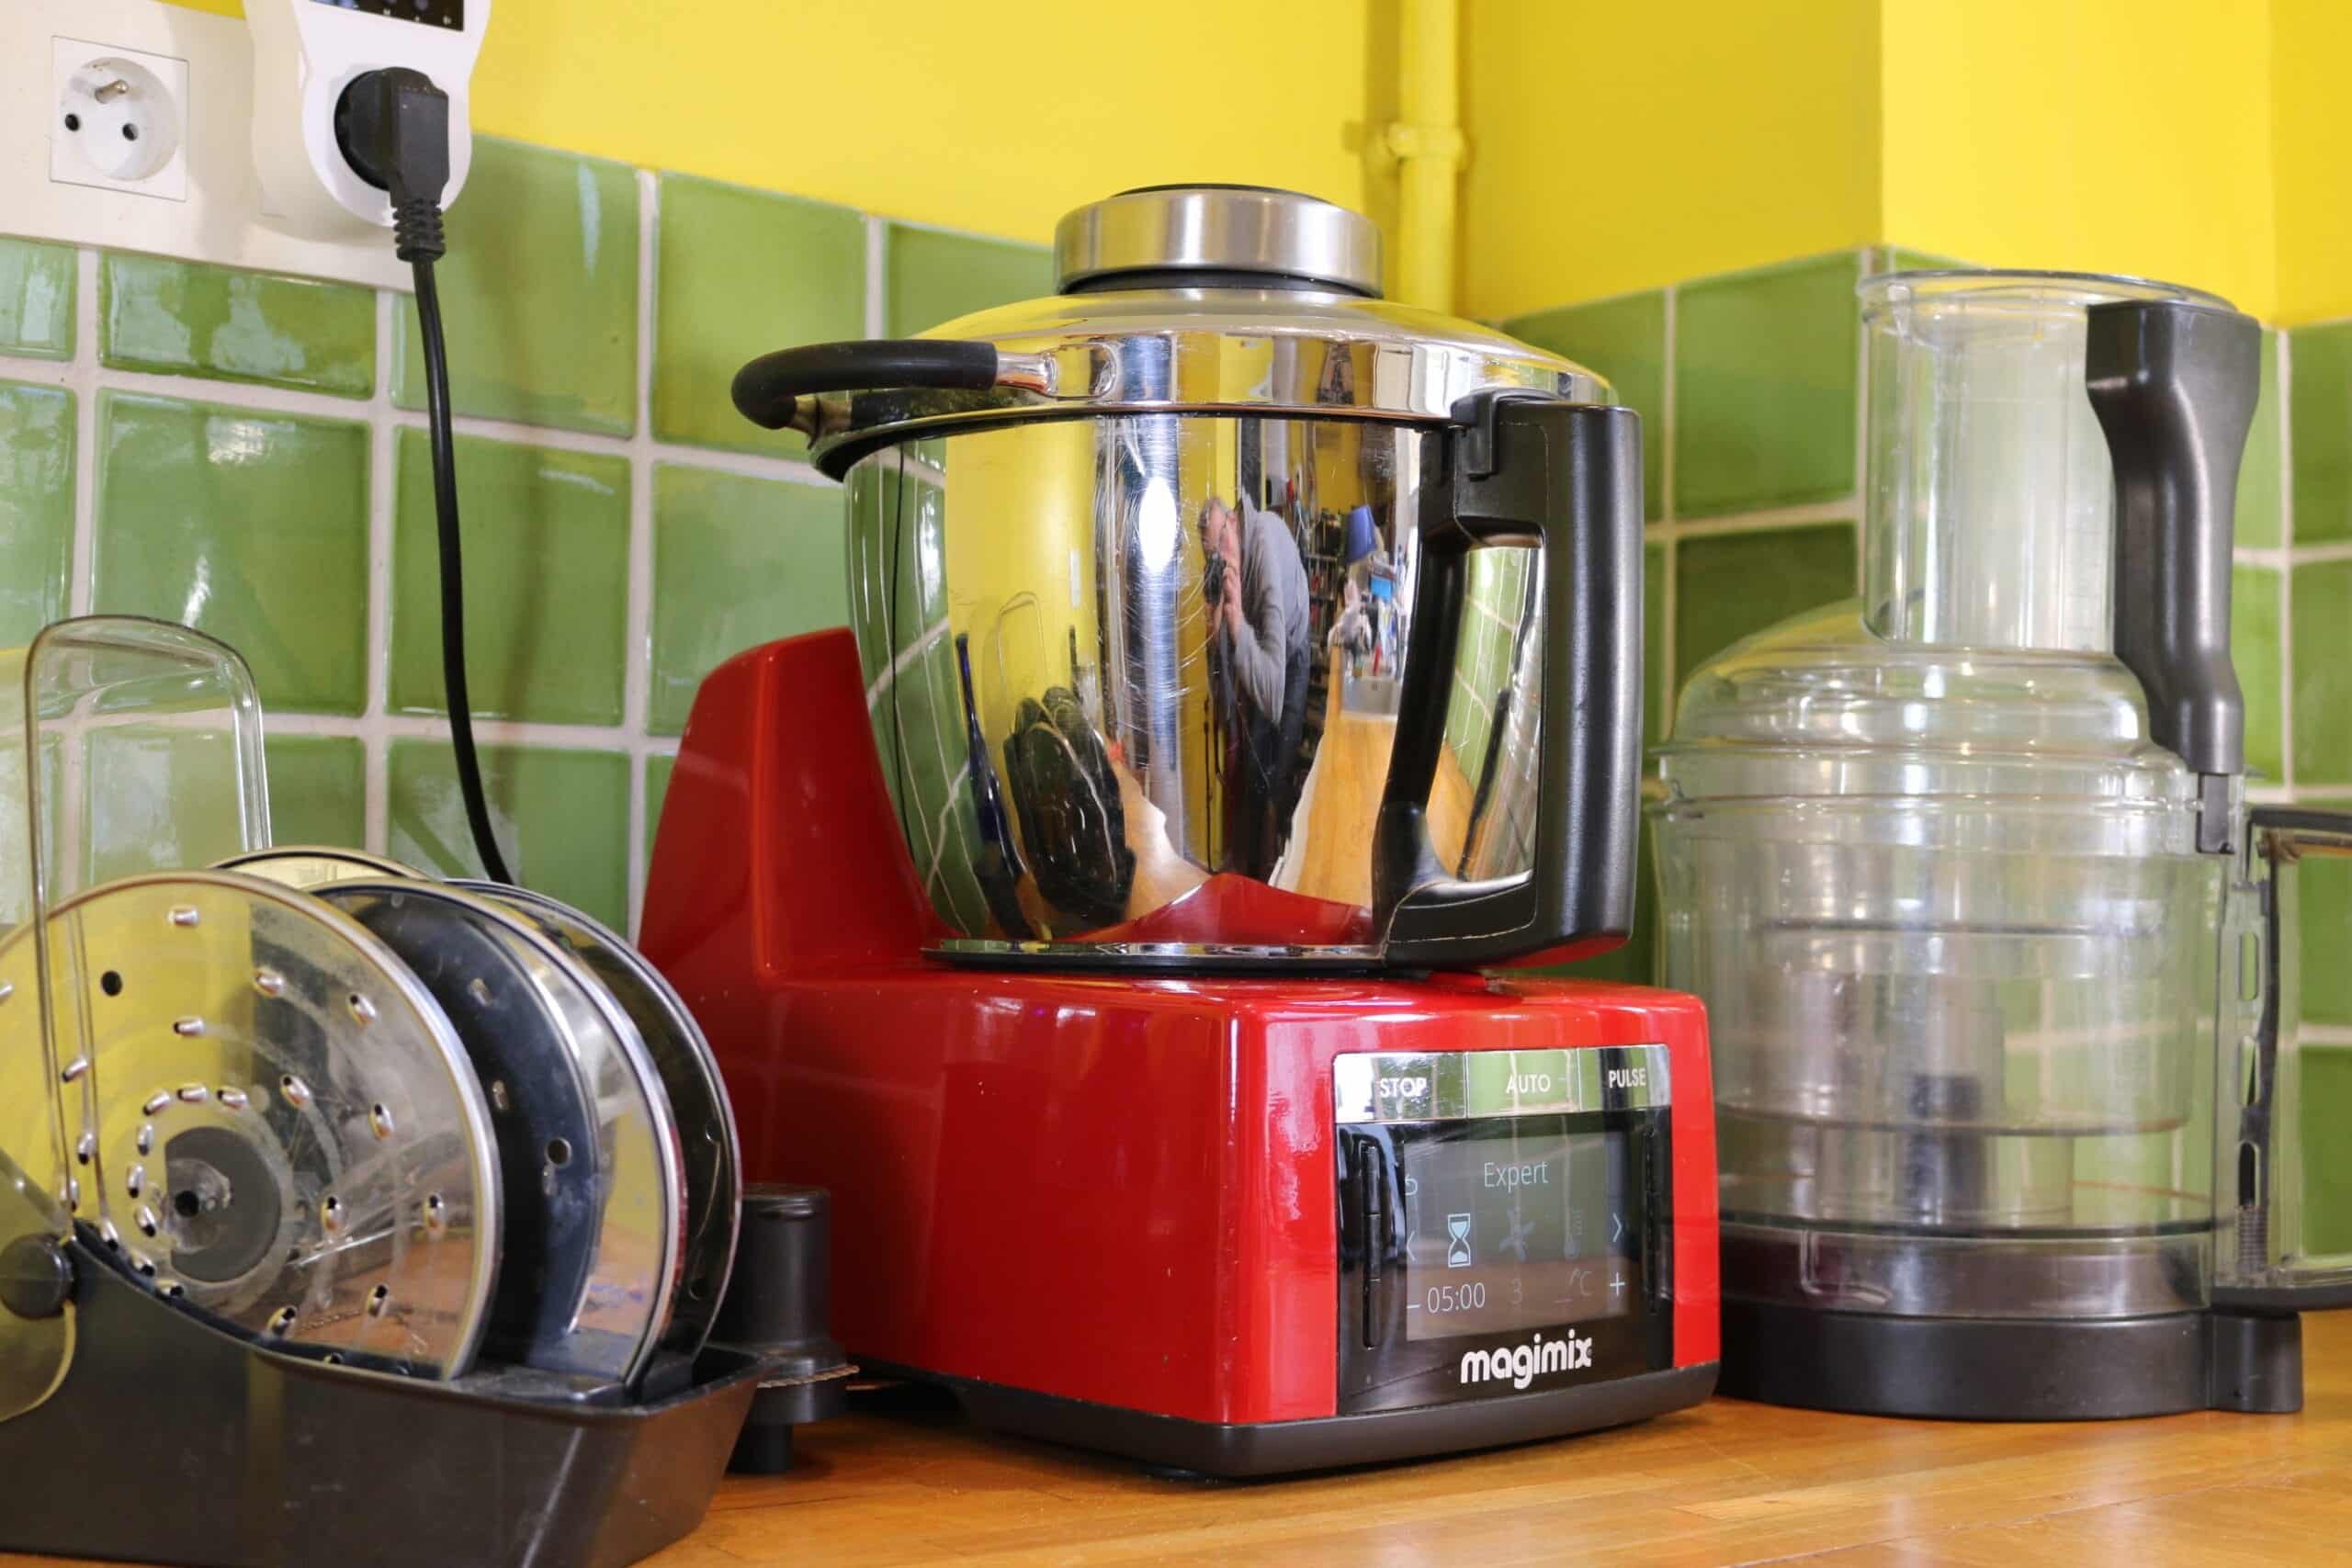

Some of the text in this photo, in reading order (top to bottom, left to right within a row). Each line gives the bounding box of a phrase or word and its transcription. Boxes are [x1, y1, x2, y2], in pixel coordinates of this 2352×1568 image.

[1379, 1077, 1427, 1098] STOP
[1506, 1073, 1551, 1094] AUTO
[1608, 1068, 1646, 1089] PULSE
[1484, 1161, 1549, 1193] Expert
[1427, 1282, 1486, 1314] 05:00
[1460, 1328, 1592, 1390] magimix
